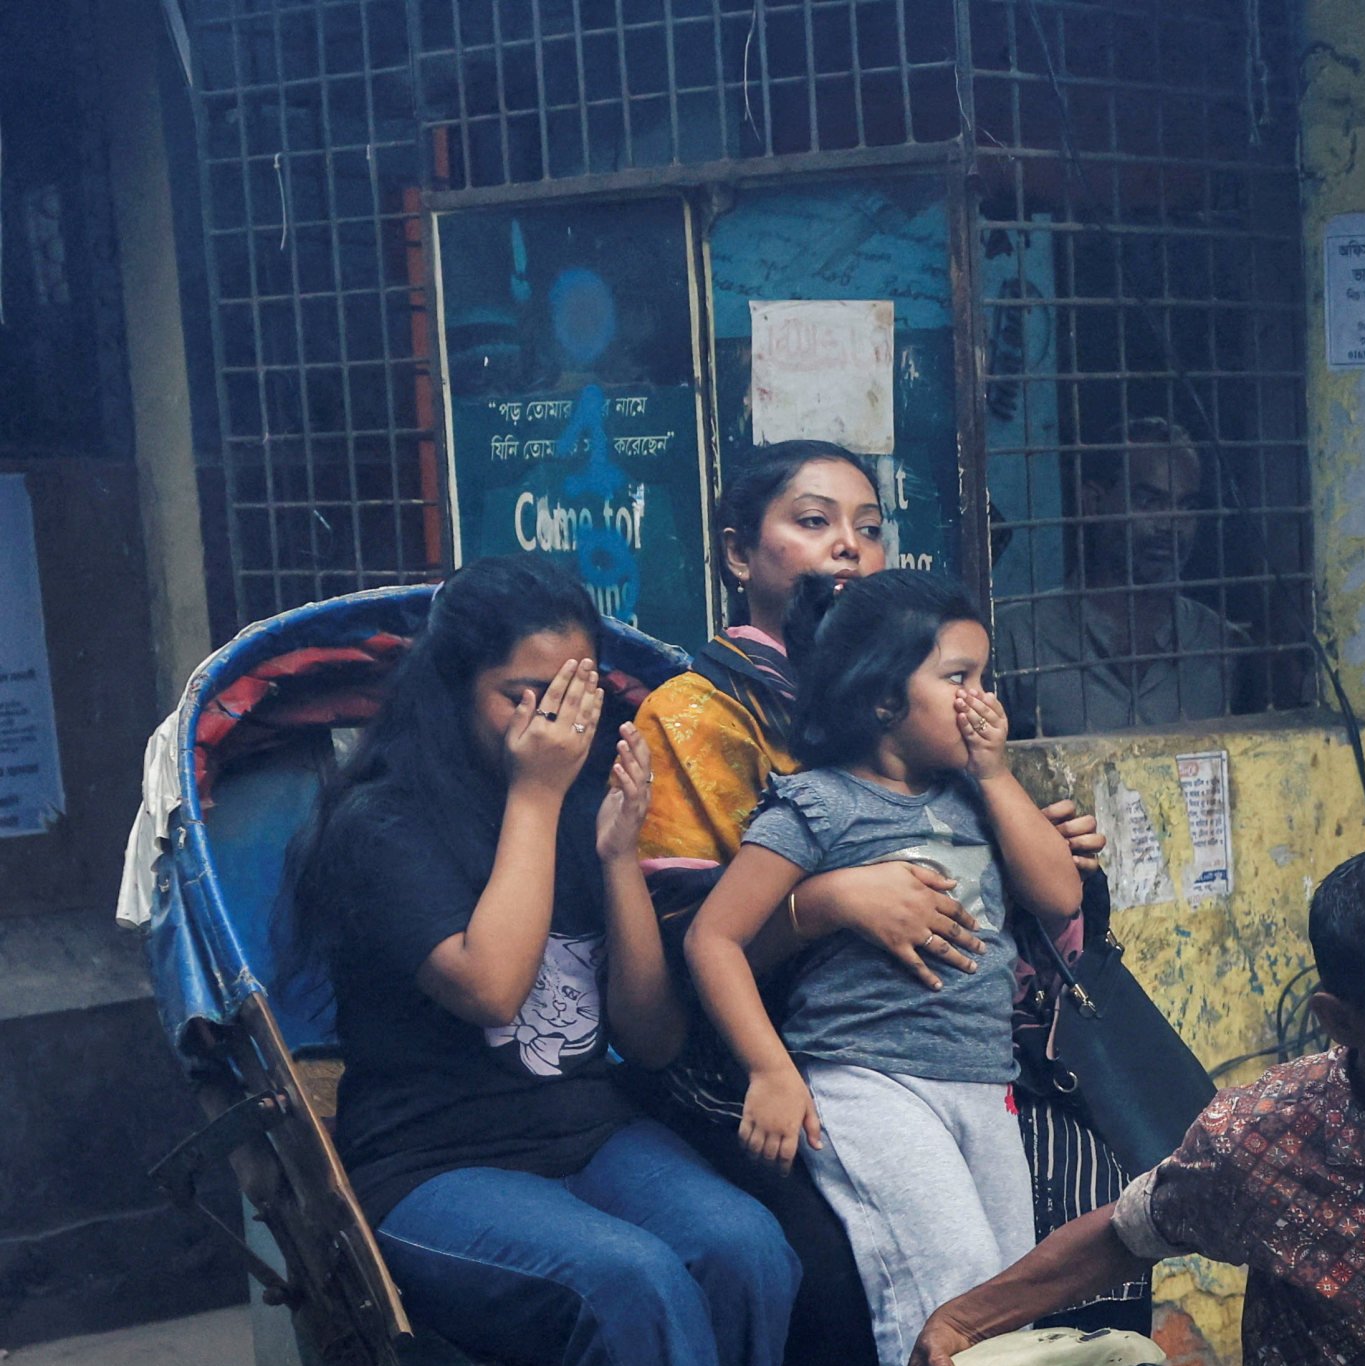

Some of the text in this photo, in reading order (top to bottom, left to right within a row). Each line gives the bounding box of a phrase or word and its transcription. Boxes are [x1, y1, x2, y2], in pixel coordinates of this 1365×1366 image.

[526, 399, 572, 421] তোমার
[616, 396, 648, 417] নামে
[490, 434, 519, 461] যিনি
